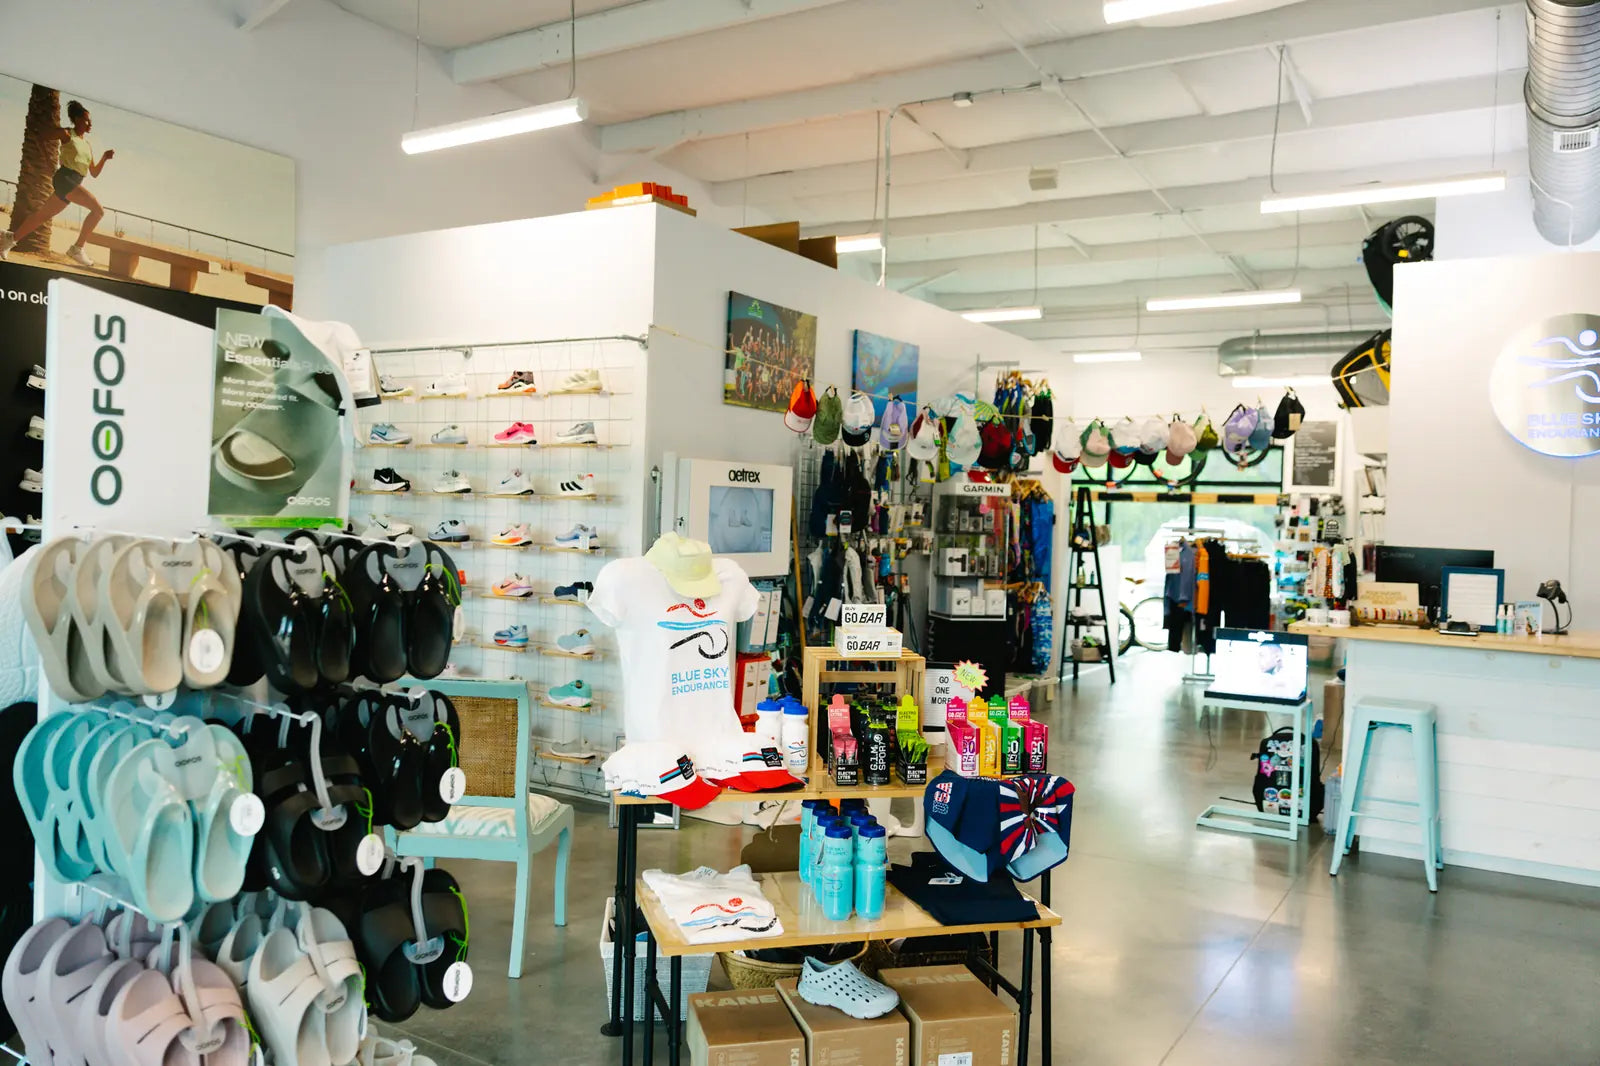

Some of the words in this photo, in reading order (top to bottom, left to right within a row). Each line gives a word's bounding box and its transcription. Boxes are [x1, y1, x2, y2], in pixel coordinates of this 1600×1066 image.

[8, 290, 27, 302] on
[224, 331, 266, 349] NEW
[91, 313, 126, 506] OOFOS
[1581, 412, 1600, 425] S
[728, 468, 761, 484] aetrex
[963, 484, 1005, 494] GARMIN
[844, 612, 858, 624] GO
[858, 612, 884, 624] BAR
[846, 640, 859, 651] GO
[859, 640, 881, 651] BAR
[671, 669, 701, 684] BLUE
[703, 666, 729, 680] SKY
[938, 676, 950, 684] GO
[960, 668, 977, 684] NEW
[671, 680, 729, 696] ENDURANCE
[935, 686, 950, 695] ONE
[932, 781, 953, 815] USA
[695, 994, 779, 1008] KANE
[1001, 1029, 1011, 1066] KANE
